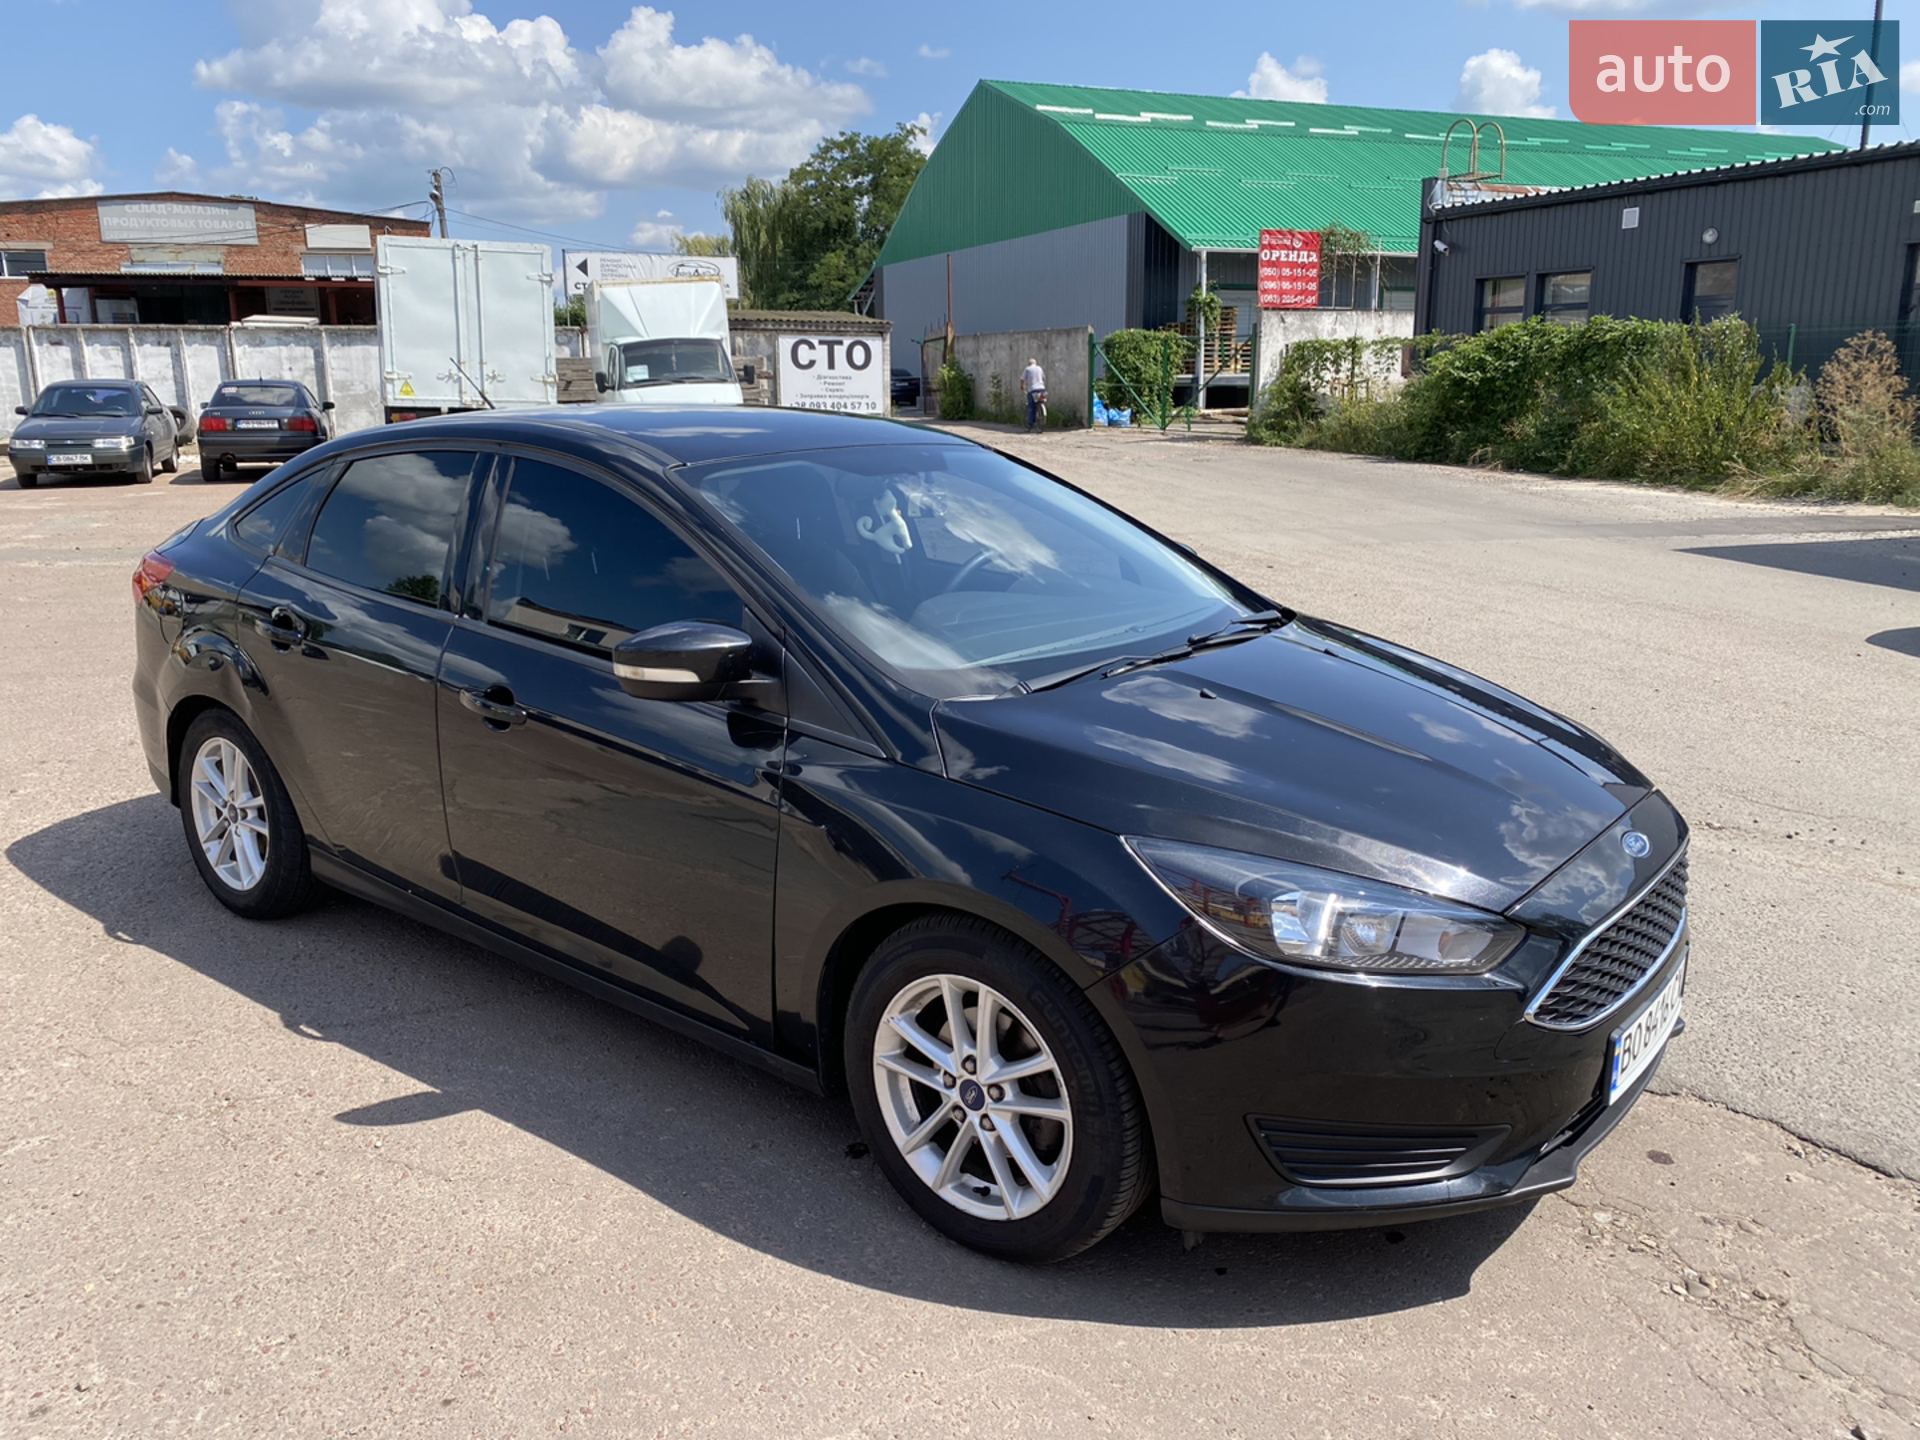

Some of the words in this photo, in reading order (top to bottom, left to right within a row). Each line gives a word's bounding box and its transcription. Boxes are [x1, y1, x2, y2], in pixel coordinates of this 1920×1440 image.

[124, 203, 229, 216] СКЛАД-МАГАЗИН
[103, 216, 196, 229] ПРОДУКТОВЫХ
[199, 219, 252, 230] ТОВАРОВ
[1261, 249, 1318, 264] ОРЕНДА
[574, 282, 588, 291] СТ
[791, 338, 872, 371] СТО
[830, 401, 848, 410] 404
[850, 401, 862, 410] 57
[865, 401, 877, 410] 10
